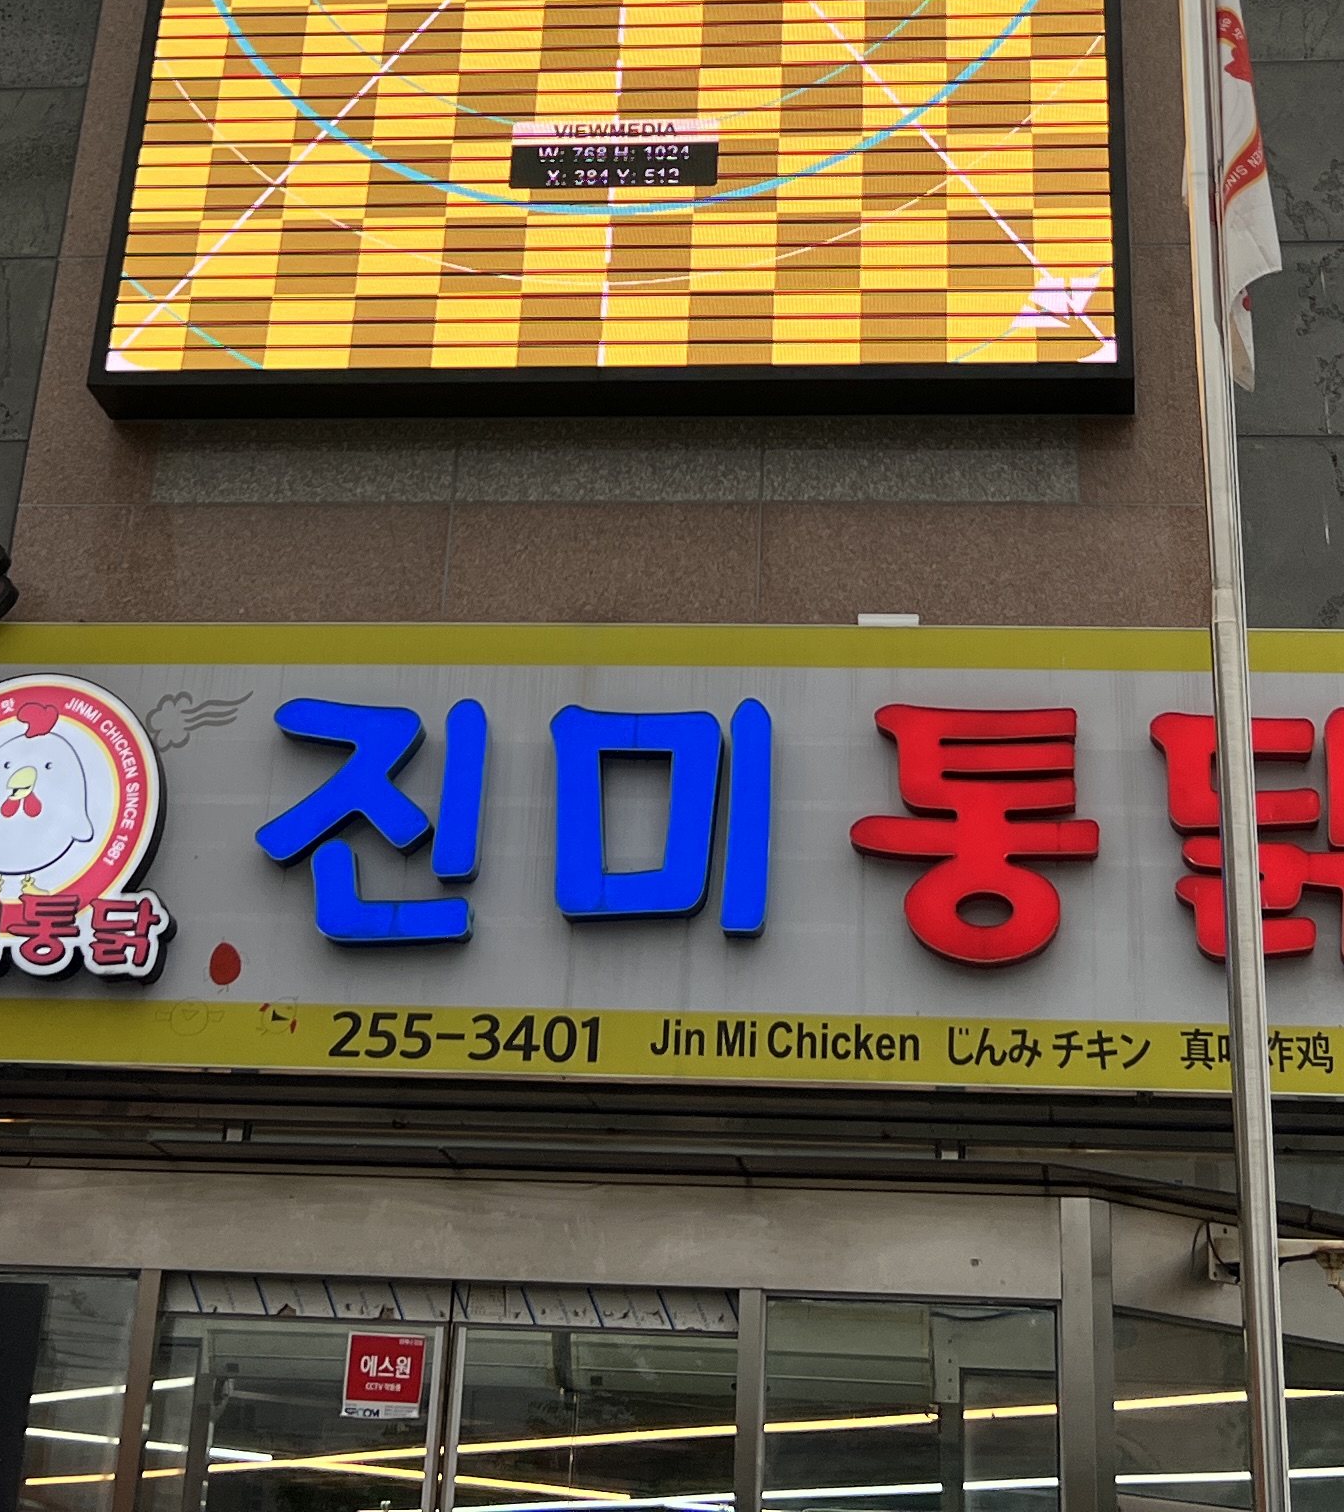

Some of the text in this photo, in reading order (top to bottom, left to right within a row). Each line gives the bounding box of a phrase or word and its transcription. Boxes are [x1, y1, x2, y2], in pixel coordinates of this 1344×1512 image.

[554, 122, 677, 138] VIEWMEDIA
[538, 145, 690, 163] W: 768 H: 1024
[545, 170, 567, 187] X:
[644, 168, 680, 184] 512
[0, 697, 16, 713] 맛
[64, 697, 141, 867] JINMI CHICKEN SINCE 1981
[329, 1010, 919, 1063] 255-3401 Jin Mi Chicken
[360, 1355, 412, 1379] 에스원
